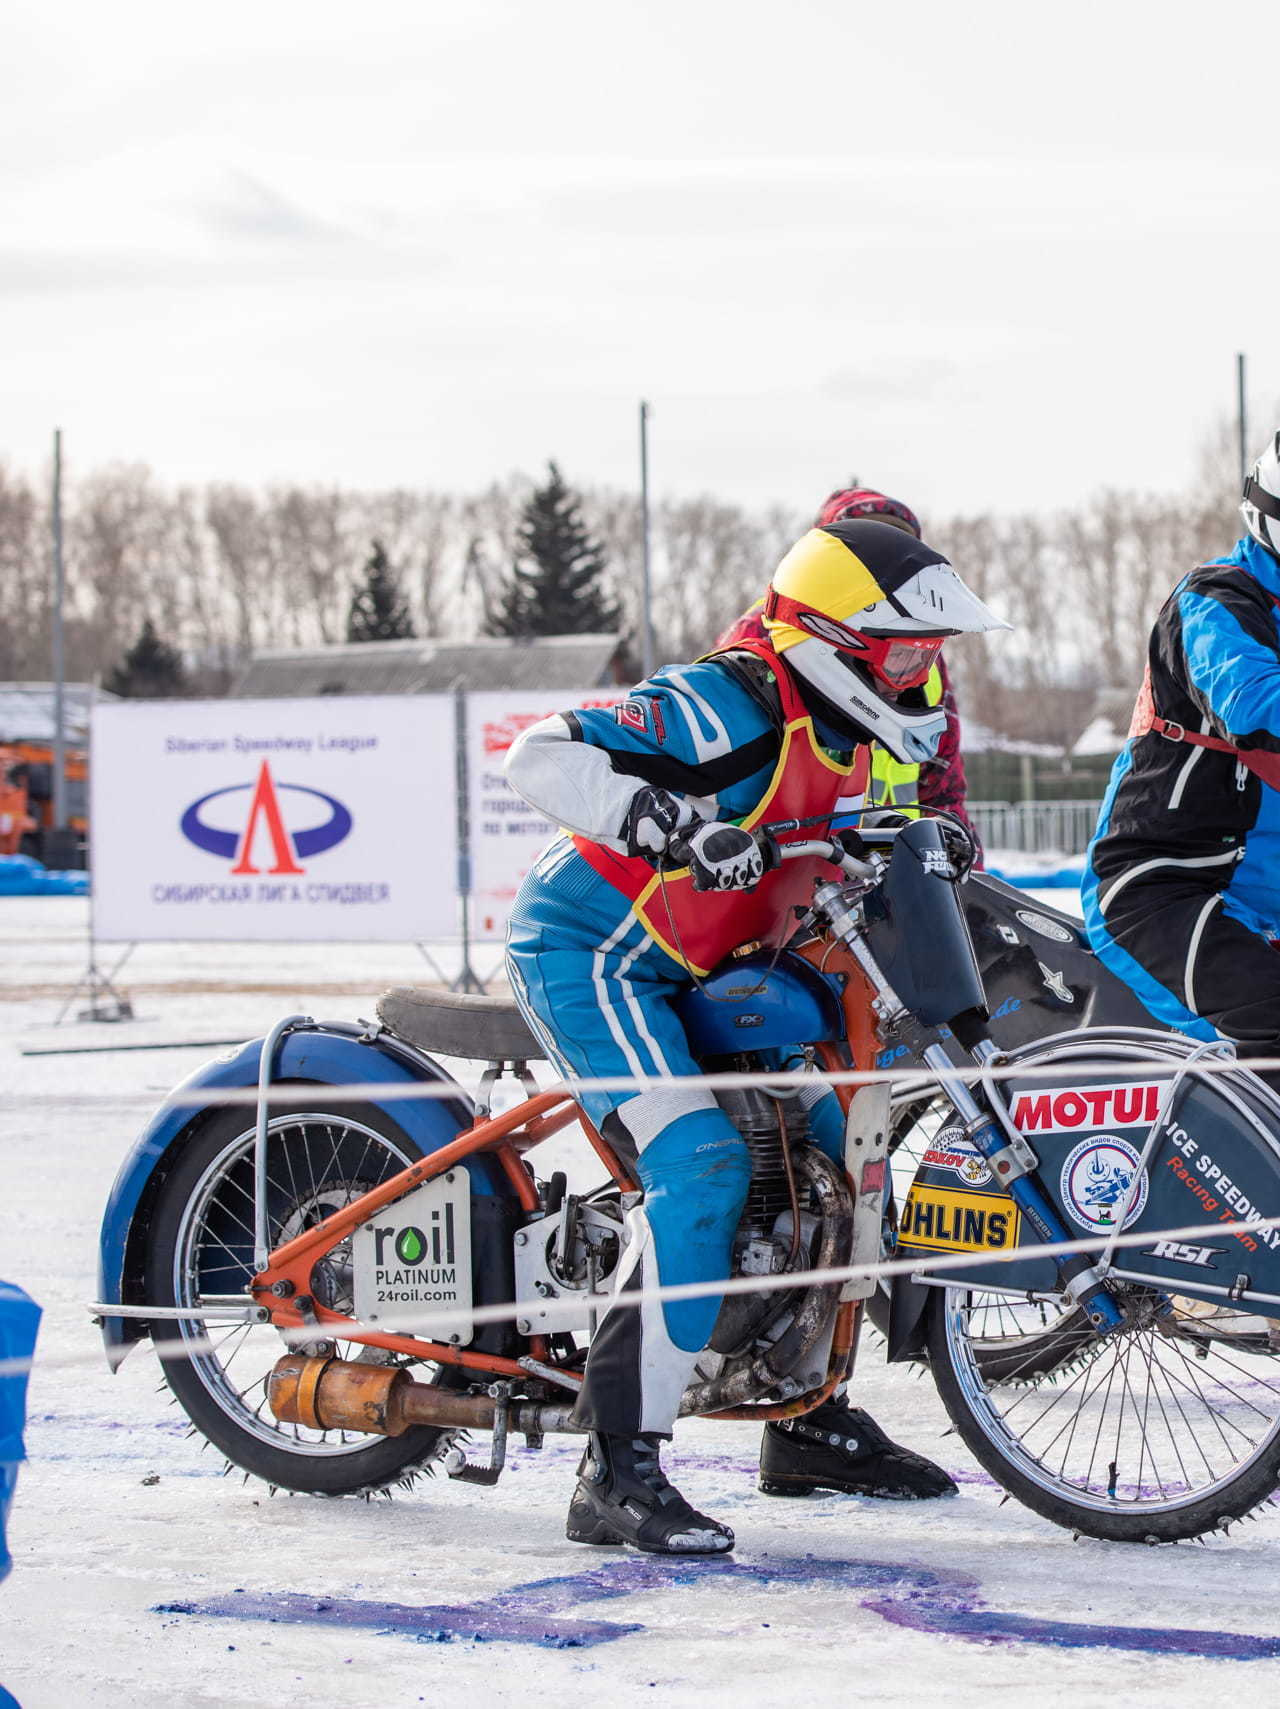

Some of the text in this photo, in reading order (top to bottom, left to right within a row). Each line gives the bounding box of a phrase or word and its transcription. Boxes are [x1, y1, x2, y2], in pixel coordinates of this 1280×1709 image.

[165, 733, 378, 755] Siberian Speedway League
[153, 881, 389, 904] СИБИРСКАЯ ЛИГА СПИДВЕЯ
[1014, 1086, 1160, 1131] MOTUL
[1166, 1121, 1199, 1158] ICE
[1166, 1156, 1220, 1211] Racing
[375, 1203, 455, 1267] roil
[376, 1269, 456, 1285] PLATINUM
[377, 1290, 457, 1302] 24roil.com
